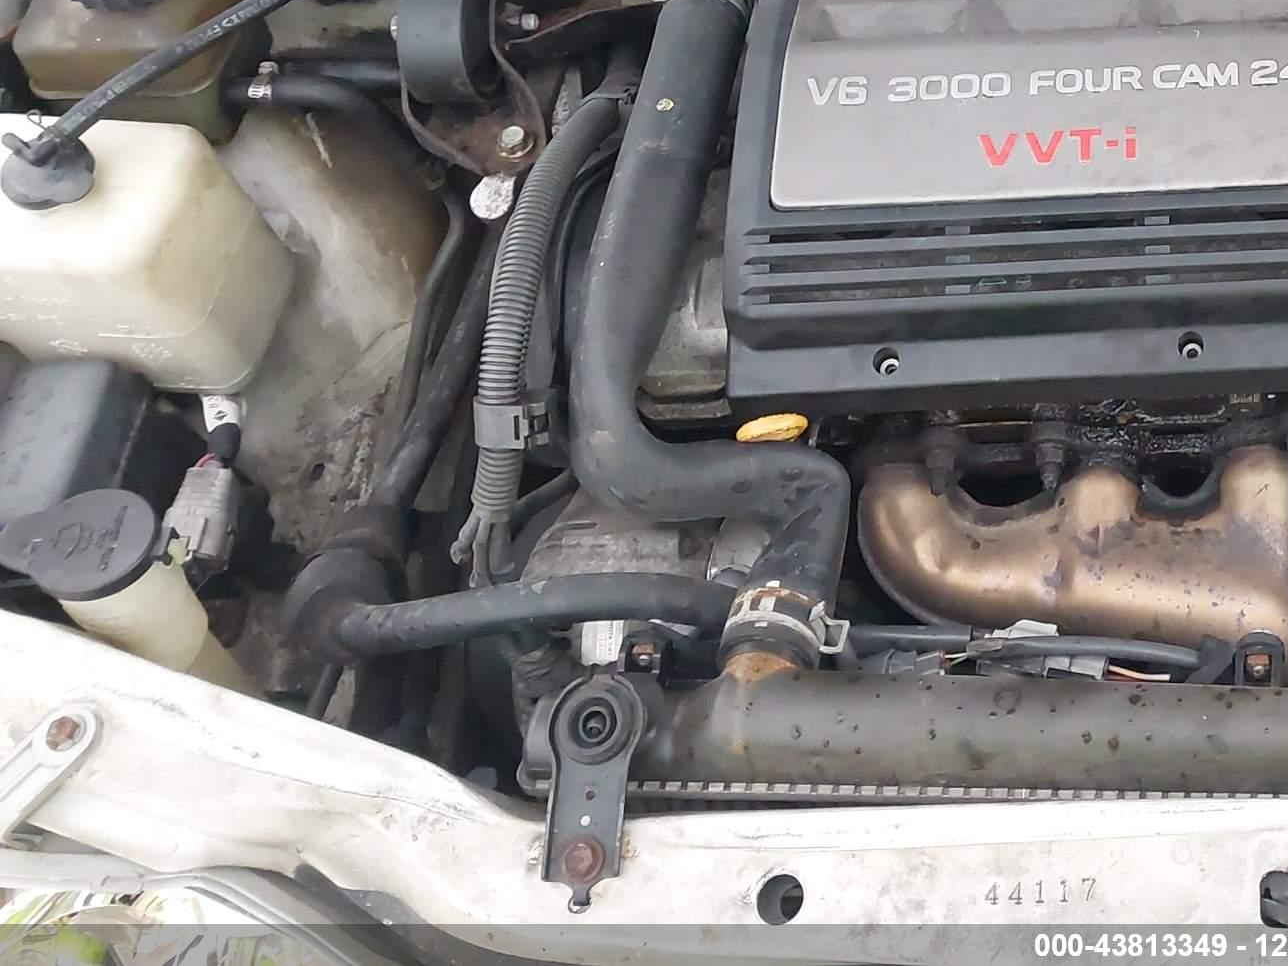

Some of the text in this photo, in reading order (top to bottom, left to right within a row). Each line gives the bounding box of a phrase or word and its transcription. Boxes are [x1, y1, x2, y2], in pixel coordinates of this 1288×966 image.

[807, 76, 868, 105] V6
[887, 72, 1011, 103] 3000
[1029, 65, 1143, 97] FOUR
[1153, 61, 1239, 90] CAM
[978, 126, 1138, 167] VVT-i
[983, 877, 1098, 906] 44117
